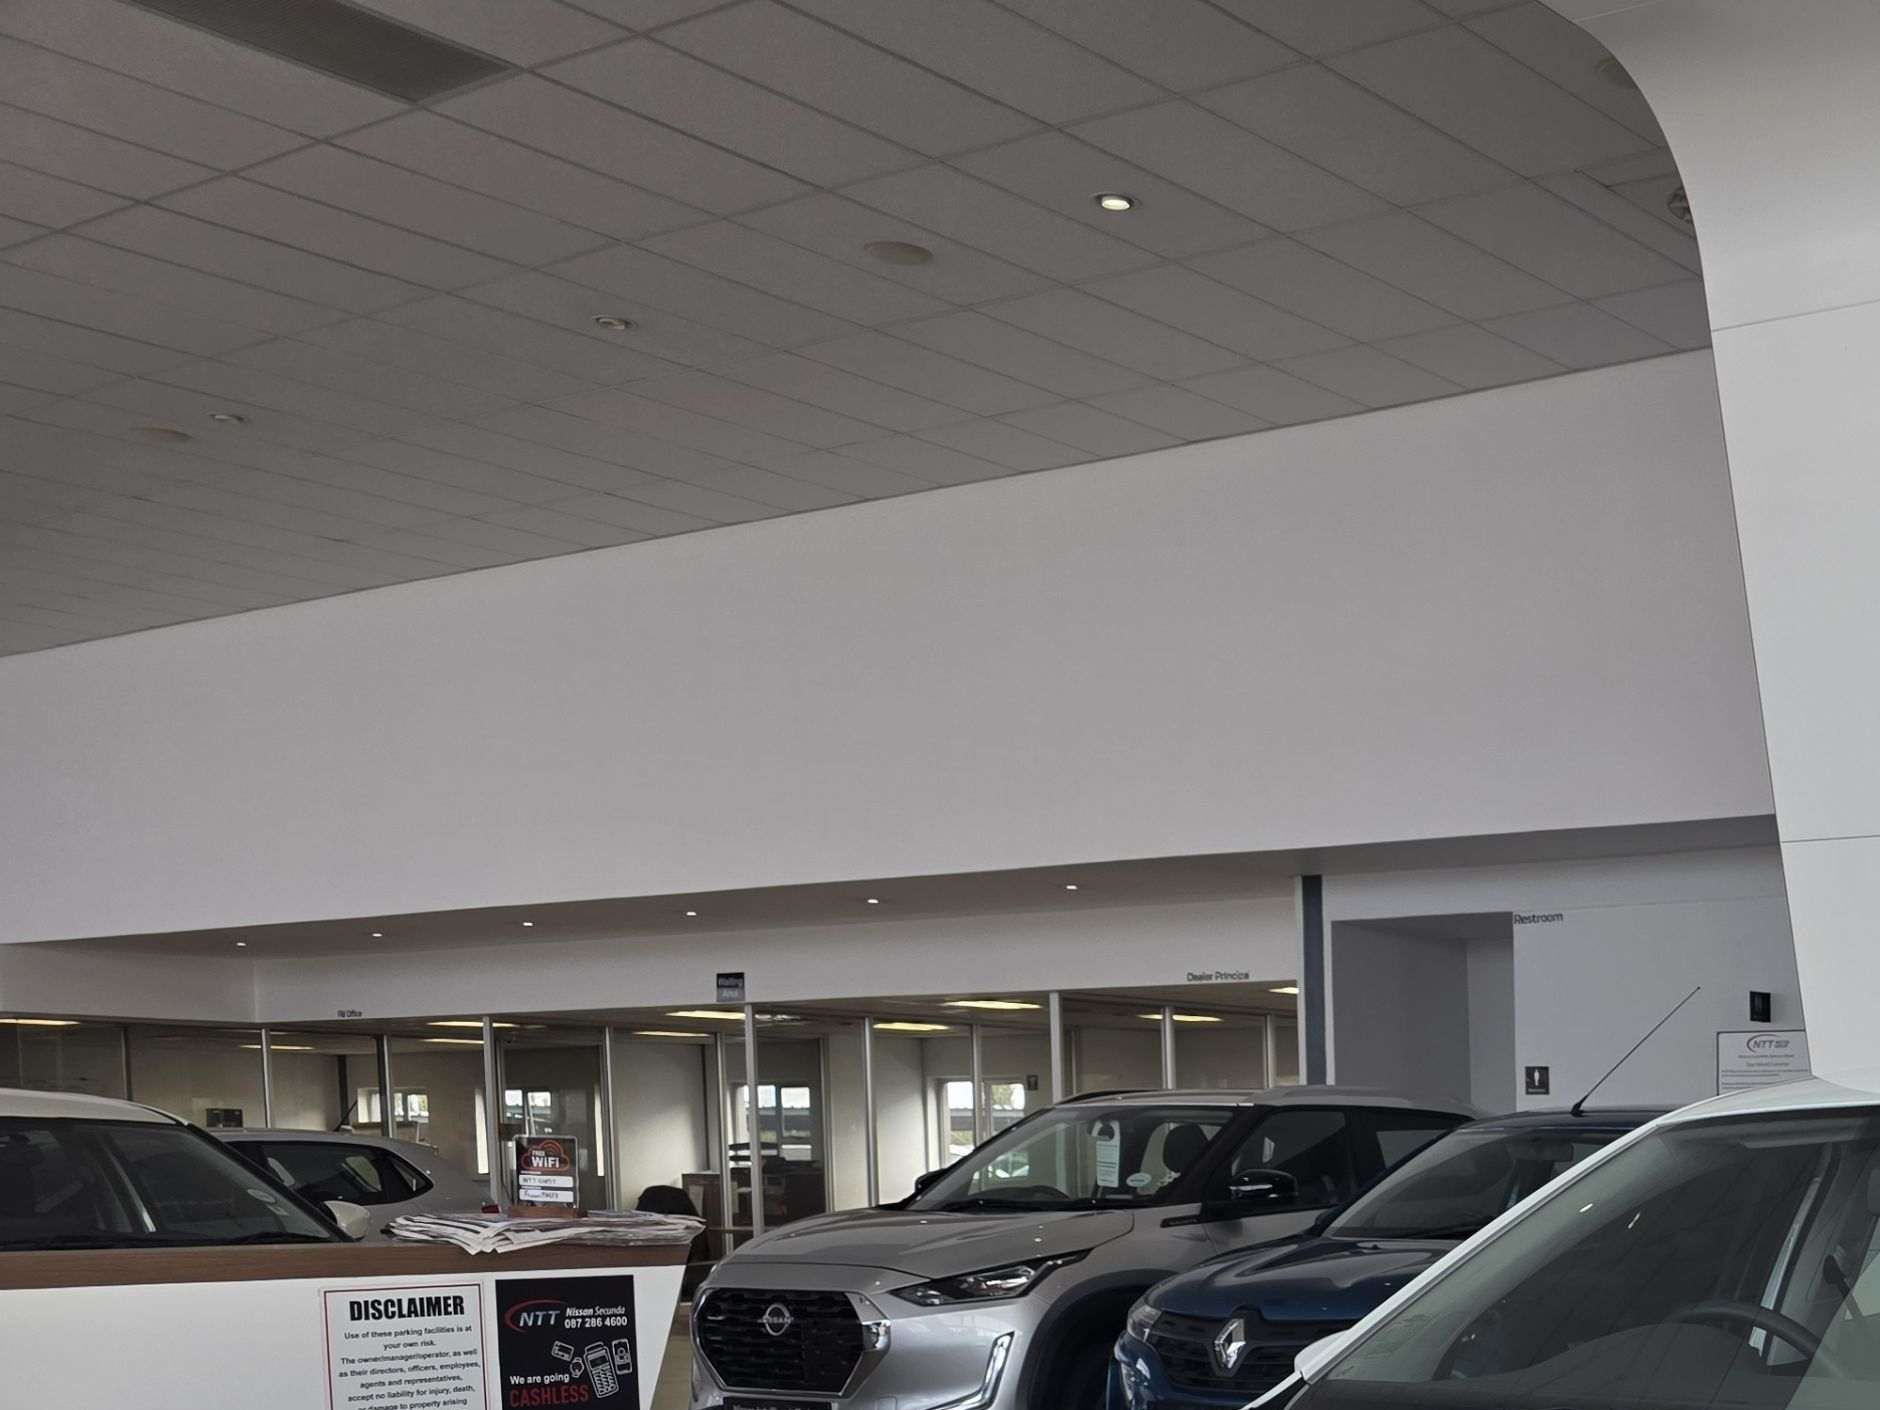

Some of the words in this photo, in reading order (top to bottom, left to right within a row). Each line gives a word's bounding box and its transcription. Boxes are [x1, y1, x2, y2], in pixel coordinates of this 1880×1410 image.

[1514, 913, 1563, 925] Restroom
[1215, 970, 1250, 981] Principa
[349, 1295, 465, 1321] DISCLAIMER
[520, 1311, 560, 1327] NTT
[566, 1308, 593, 1317] Nissan
[595, 1306, 625, 1316] Secunda
[564, 1318, 582, 1328] 087
[585, 1318, 602, 1327] 286
[604, 1316, 628, 1326] 4600
[344, 1331, 359, 1340] Use
[371, 1330, 392, 1338] these
[394, 1328, 423, 1340] parking
[424, 1326, 455, 1335] facilities
[383, 1342, 401, 1351] your
[403, 1341, 418, 1349] own
[341, 1357, 355, 1366] The
[350, 1369, 368, 1377] their
[510, 1375, 525, 1384] We
[544, 1373, 570, 1383] going
[360, 1380, 386, 1389] agents
[348, 1394, 374, 1402] accept
[387, 1390, 414, 1399] liability
[416, 1388, 428, 1396] for
[509, 1385, 589, 1407] CASHLESS
[409, 1400, 441, 1410] property
[442, 1398, 468, 1406] arising
